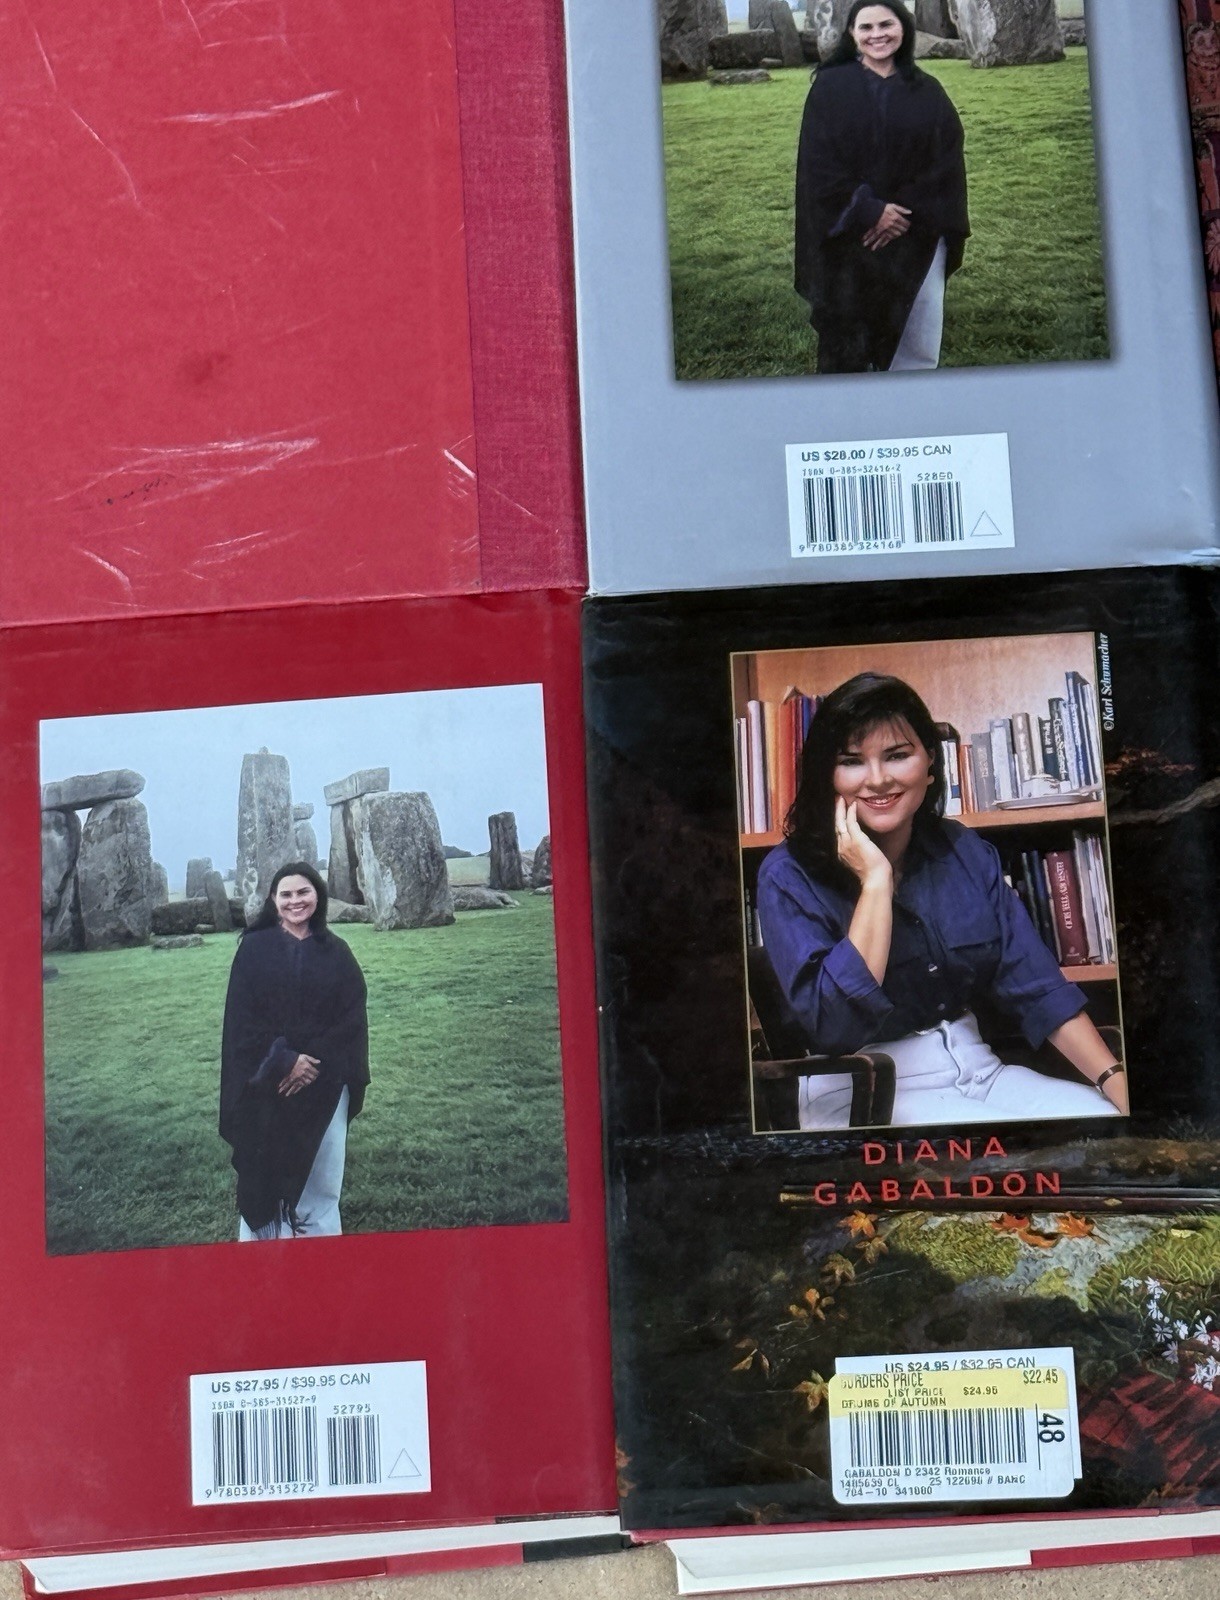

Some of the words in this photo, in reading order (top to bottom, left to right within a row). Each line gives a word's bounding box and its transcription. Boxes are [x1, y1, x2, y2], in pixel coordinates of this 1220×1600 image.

[801, 452, 820, 462] US
[823, 449, 866, 461] $28.00
[869, 448, 874, 459] /
[877, 447, 919, 459] $39.95
[922, 444, 952, 455] CAN
[802, 467, 824, 477] ISBN
[829, 463, 901, 475] 0-385-32416-2
[917, 471, 953, 482] 52850
[811, 541, 854, 552] 780385
[857, 540, 902, 551] 324168
[1098, 633, 1113, 696] Schumacher
[864, 1136, 1008, 1165] DIANA
[813, 1172, 1061, 1205] GABALDON
[885, 1362, 902, 1374] US
[907, 1360, 950, 1372] $24.95
[960, 1358, 1003, 1370] $32.95
[1006, 1356, 1036, 1368] CAN
[211, 1381, 231, 1393] US
[235, 1378, 279, 1393] $27.95
[283, 1377, 288, 1390] /
[291, 1375, 336, 1389] $39.95
[340, 1372, 371, 1386] CAN
[893, 1372, 924, 1388] PRICE
[1022, 1369, 1059, 1385] $22.45
[888, 1388, 909, 1398] LIST
[920, 1387, 943, 1397] PRICE
[212, 1400, 235, 1410] ISBN
[240, 1395, 317, 1408] 0-385-31527-9
[333, 1403, 371, 1414] 52795
[883, 1398, 896, 1408] OF
[901, 1397, 946, 1407] AUTUMN
[1038, 1412, 1065, 1443] 48
[844, 1467, 901, 1479] GABALDON
[904, 1467, 912, 1477] D
[915, 1466, 941, 1477] 2342
[944, 1466, 991, 1476] Romance
[887, 1477, 899, 1487] CL
[929, 1476, 942, 1486] 25
[217, 1486, 264, 1498] 780385
[268, 1483, 315, 1495] 315272
